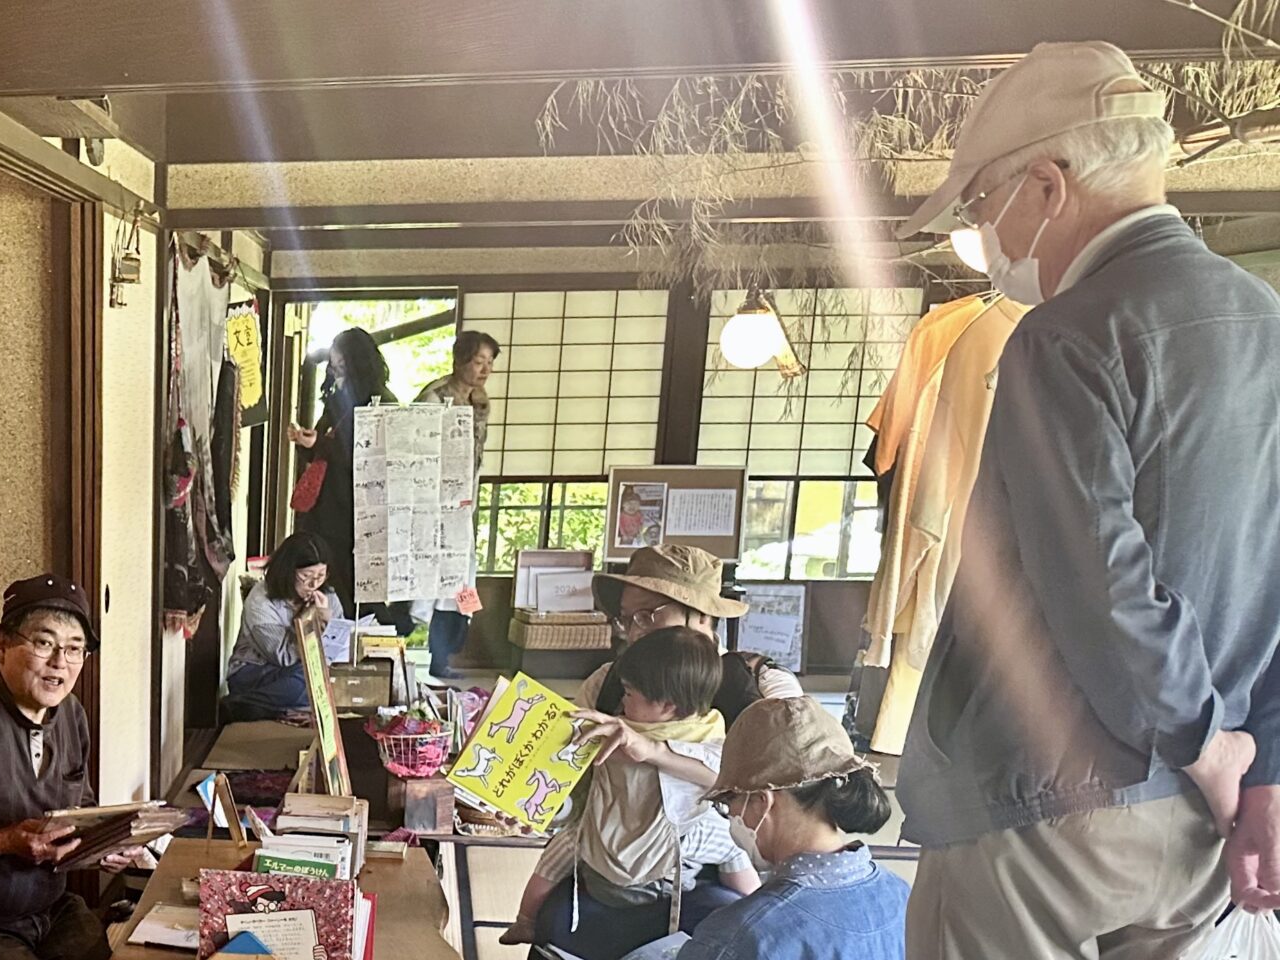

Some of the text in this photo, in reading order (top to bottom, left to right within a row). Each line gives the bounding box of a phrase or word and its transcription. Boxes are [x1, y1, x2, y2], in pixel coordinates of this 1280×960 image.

[263, 858, 330, 877] エルマーのぼうけん
